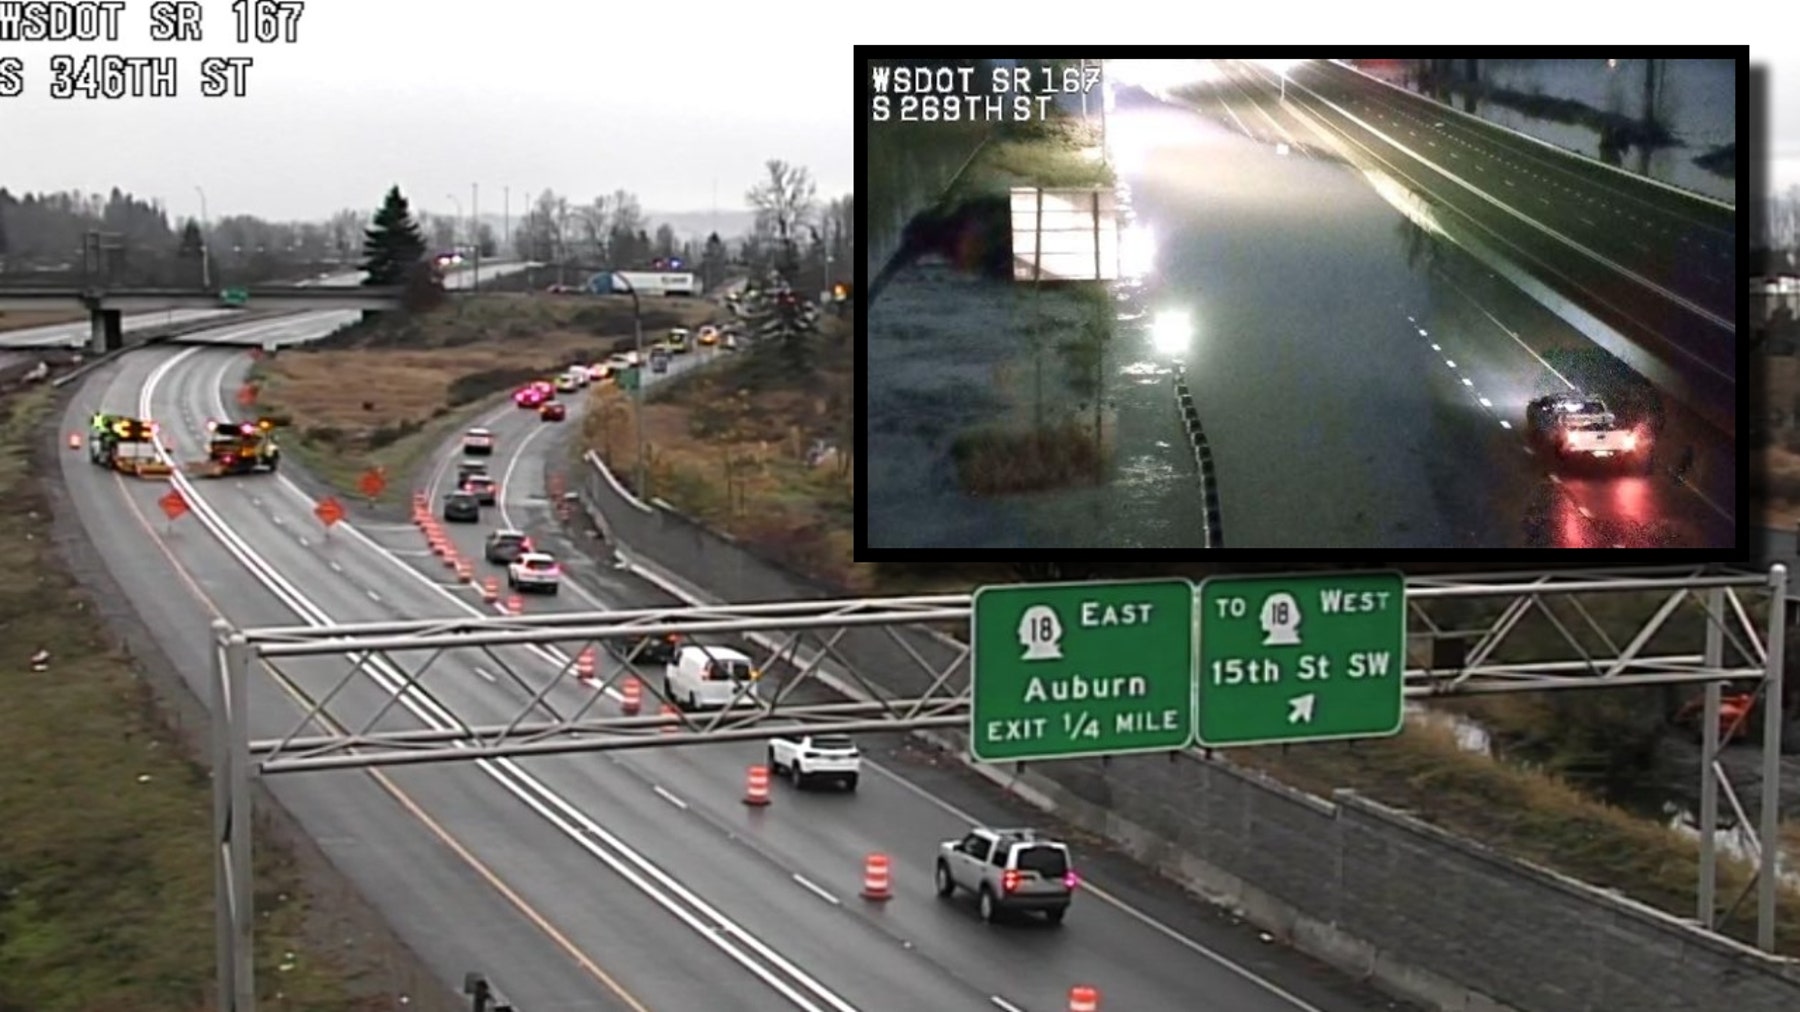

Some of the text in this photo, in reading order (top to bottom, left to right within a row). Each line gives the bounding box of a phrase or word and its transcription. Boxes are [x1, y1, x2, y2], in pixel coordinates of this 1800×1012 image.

[1031, 602, 1153, 642] 18 EAST
[1216, 598, 1246, 619] TO
[1272, 602, 1289, 626] 18
[1212, 651, 1390, 685] 15th St SW
[1023, 674, 1146, 703] Auburn
[987, 710, 1178, 741] EXIT 1/4 MILE
